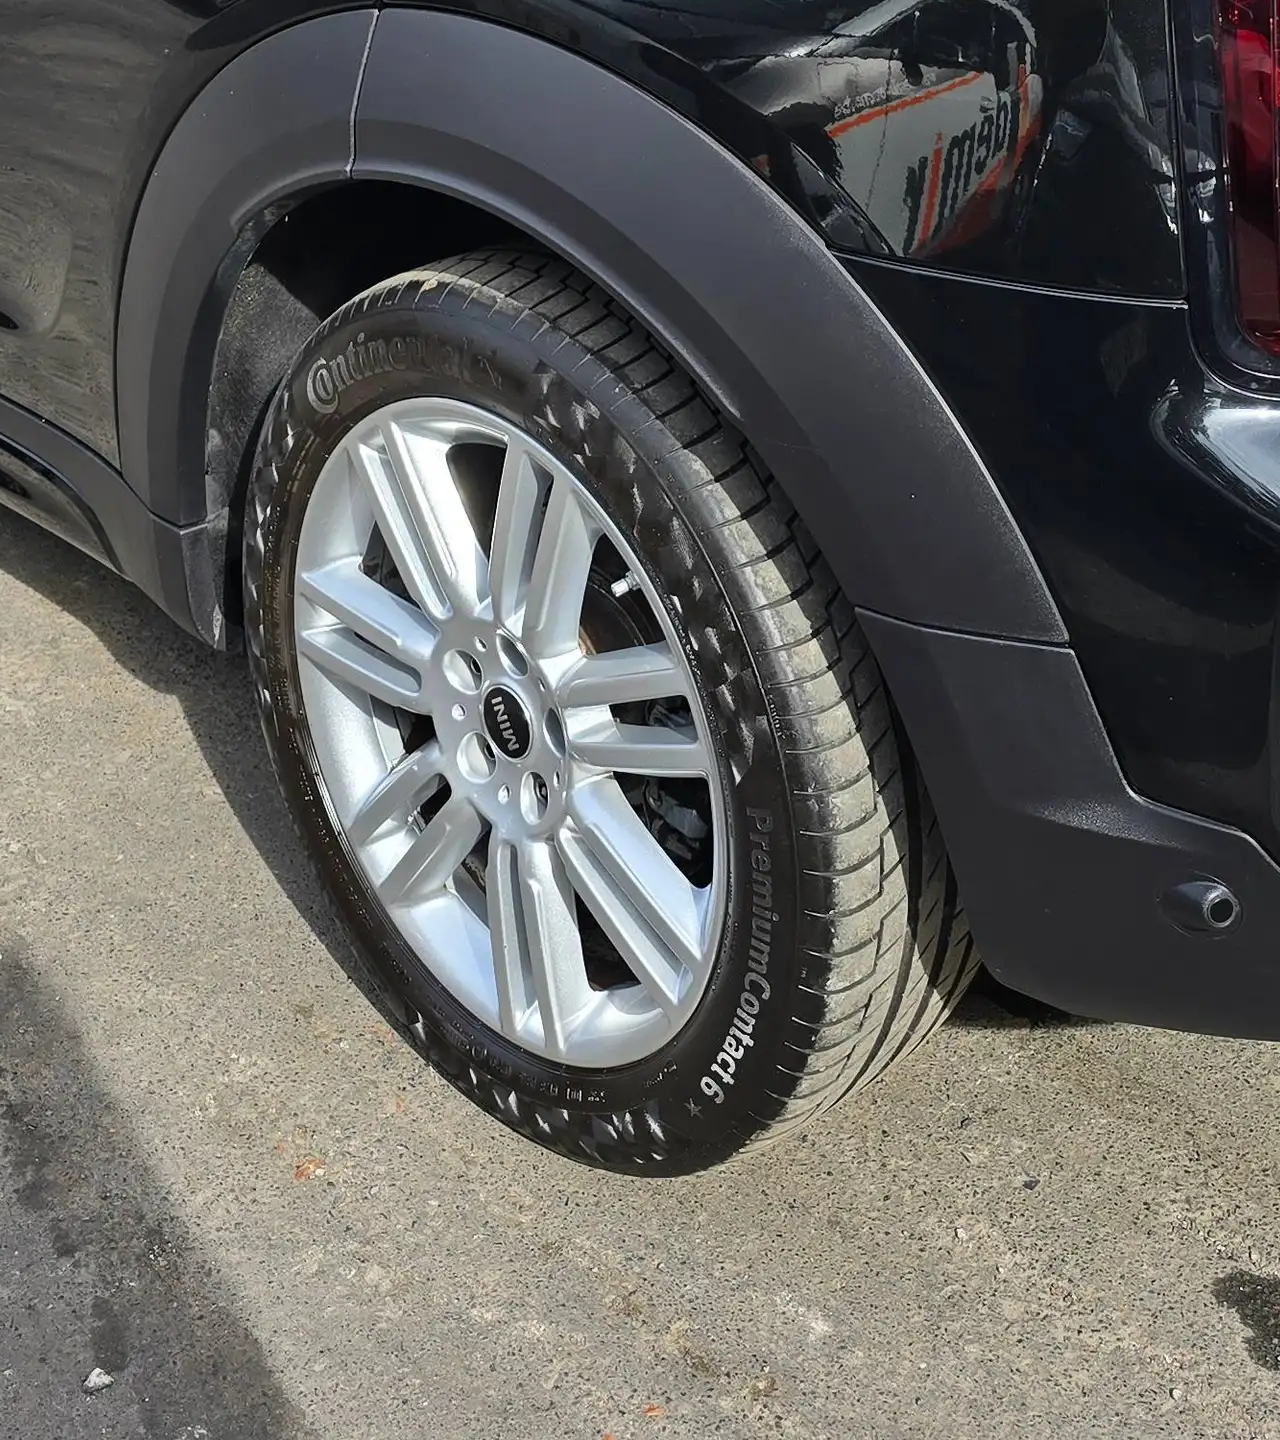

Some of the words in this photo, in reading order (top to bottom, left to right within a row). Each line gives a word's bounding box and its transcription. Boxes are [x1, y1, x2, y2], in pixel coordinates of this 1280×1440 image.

[306, 332, 478, 415] Continental
[491, 696, 520, 751] MINI
[699, 1075, 725, 1105] 6
